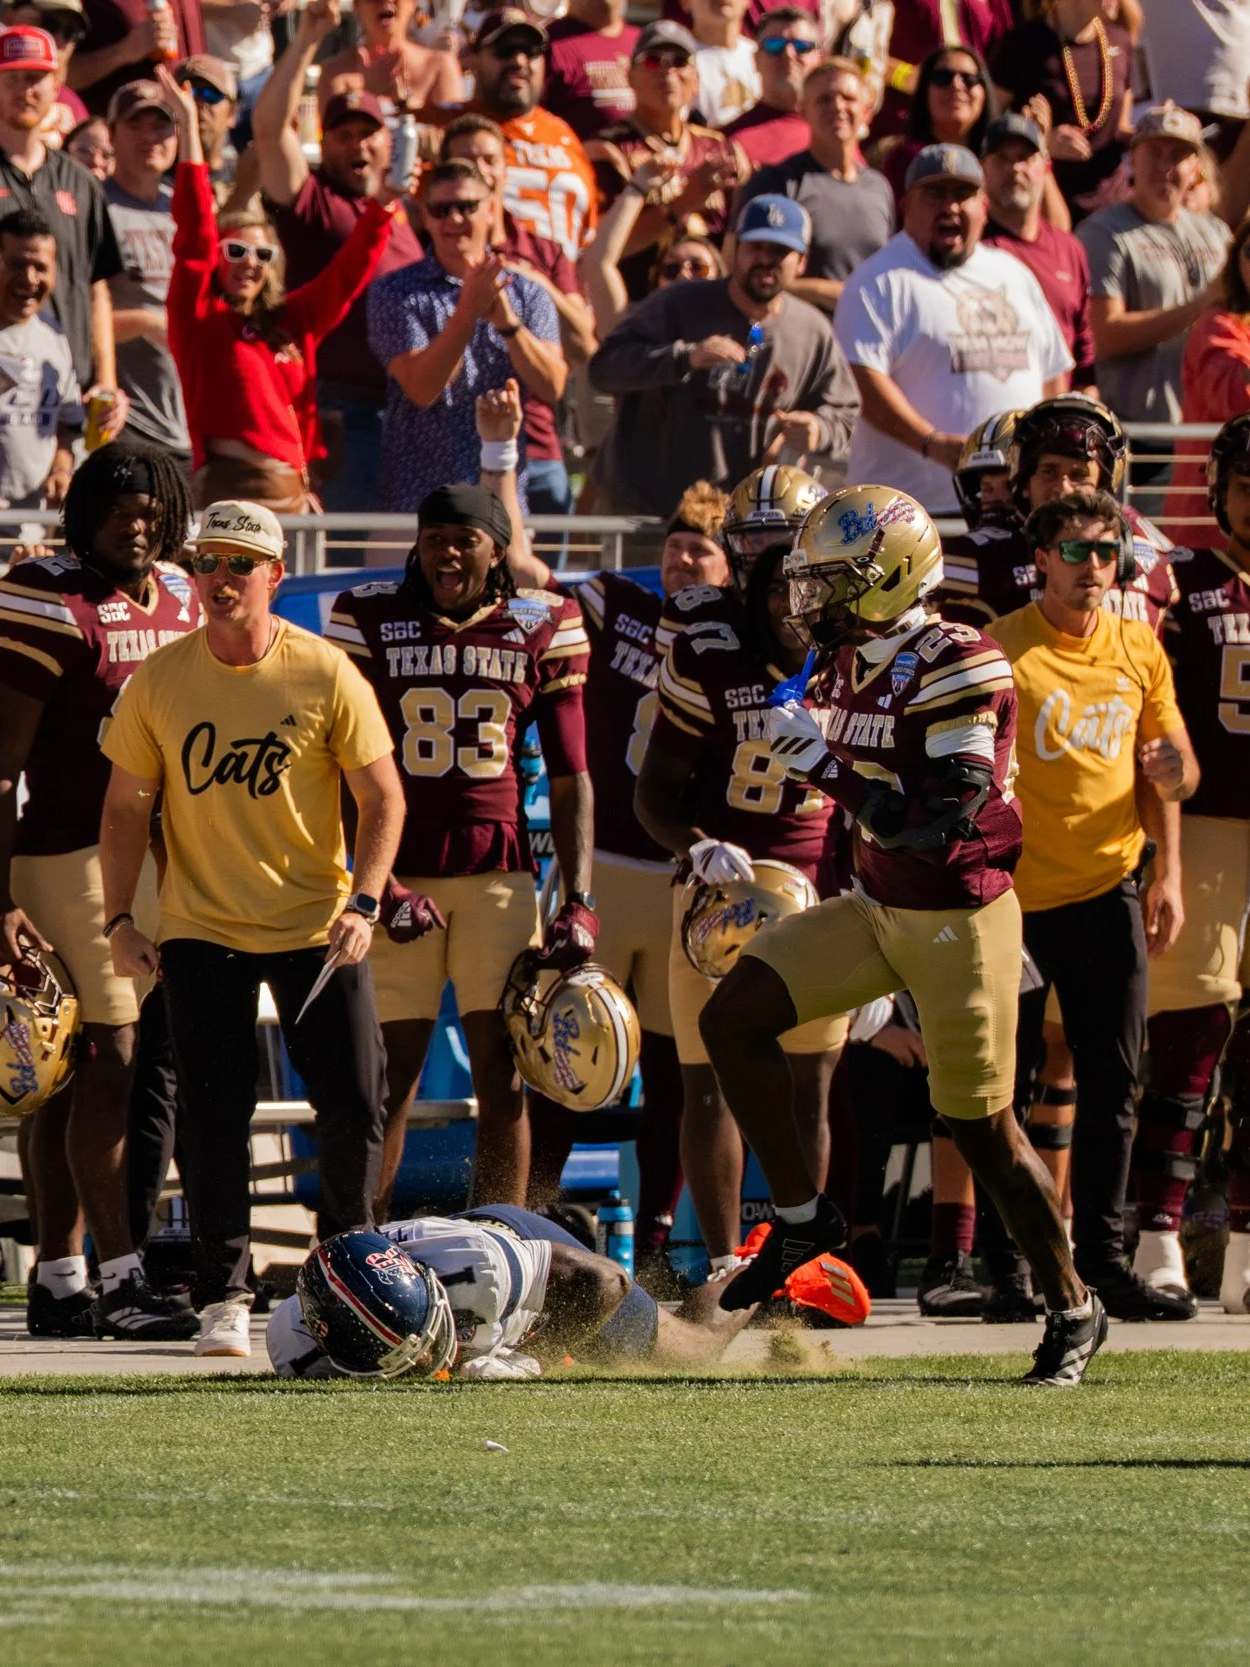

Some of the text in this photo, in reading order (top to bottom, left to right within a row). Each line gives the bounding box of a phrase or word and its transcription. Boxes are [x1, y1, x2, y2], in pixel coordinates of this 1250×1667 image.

[381, 621, 421, 642] SBC
[613, 613, 654, 645] SBC
[916, 621, 981, 663] 23
[385, 644, 457, 678] TEXAS
[463, 645, 529, 685] STATE
[609, 640, 660, 685] TEXA
[724, 684, 766, 709] SBC
[399, 686, 513, 779] 83
[842, 712, 896, 749] STATE
[1034, 688, 1134, 761] Cats
[181, 721, 292, 800] Cats
